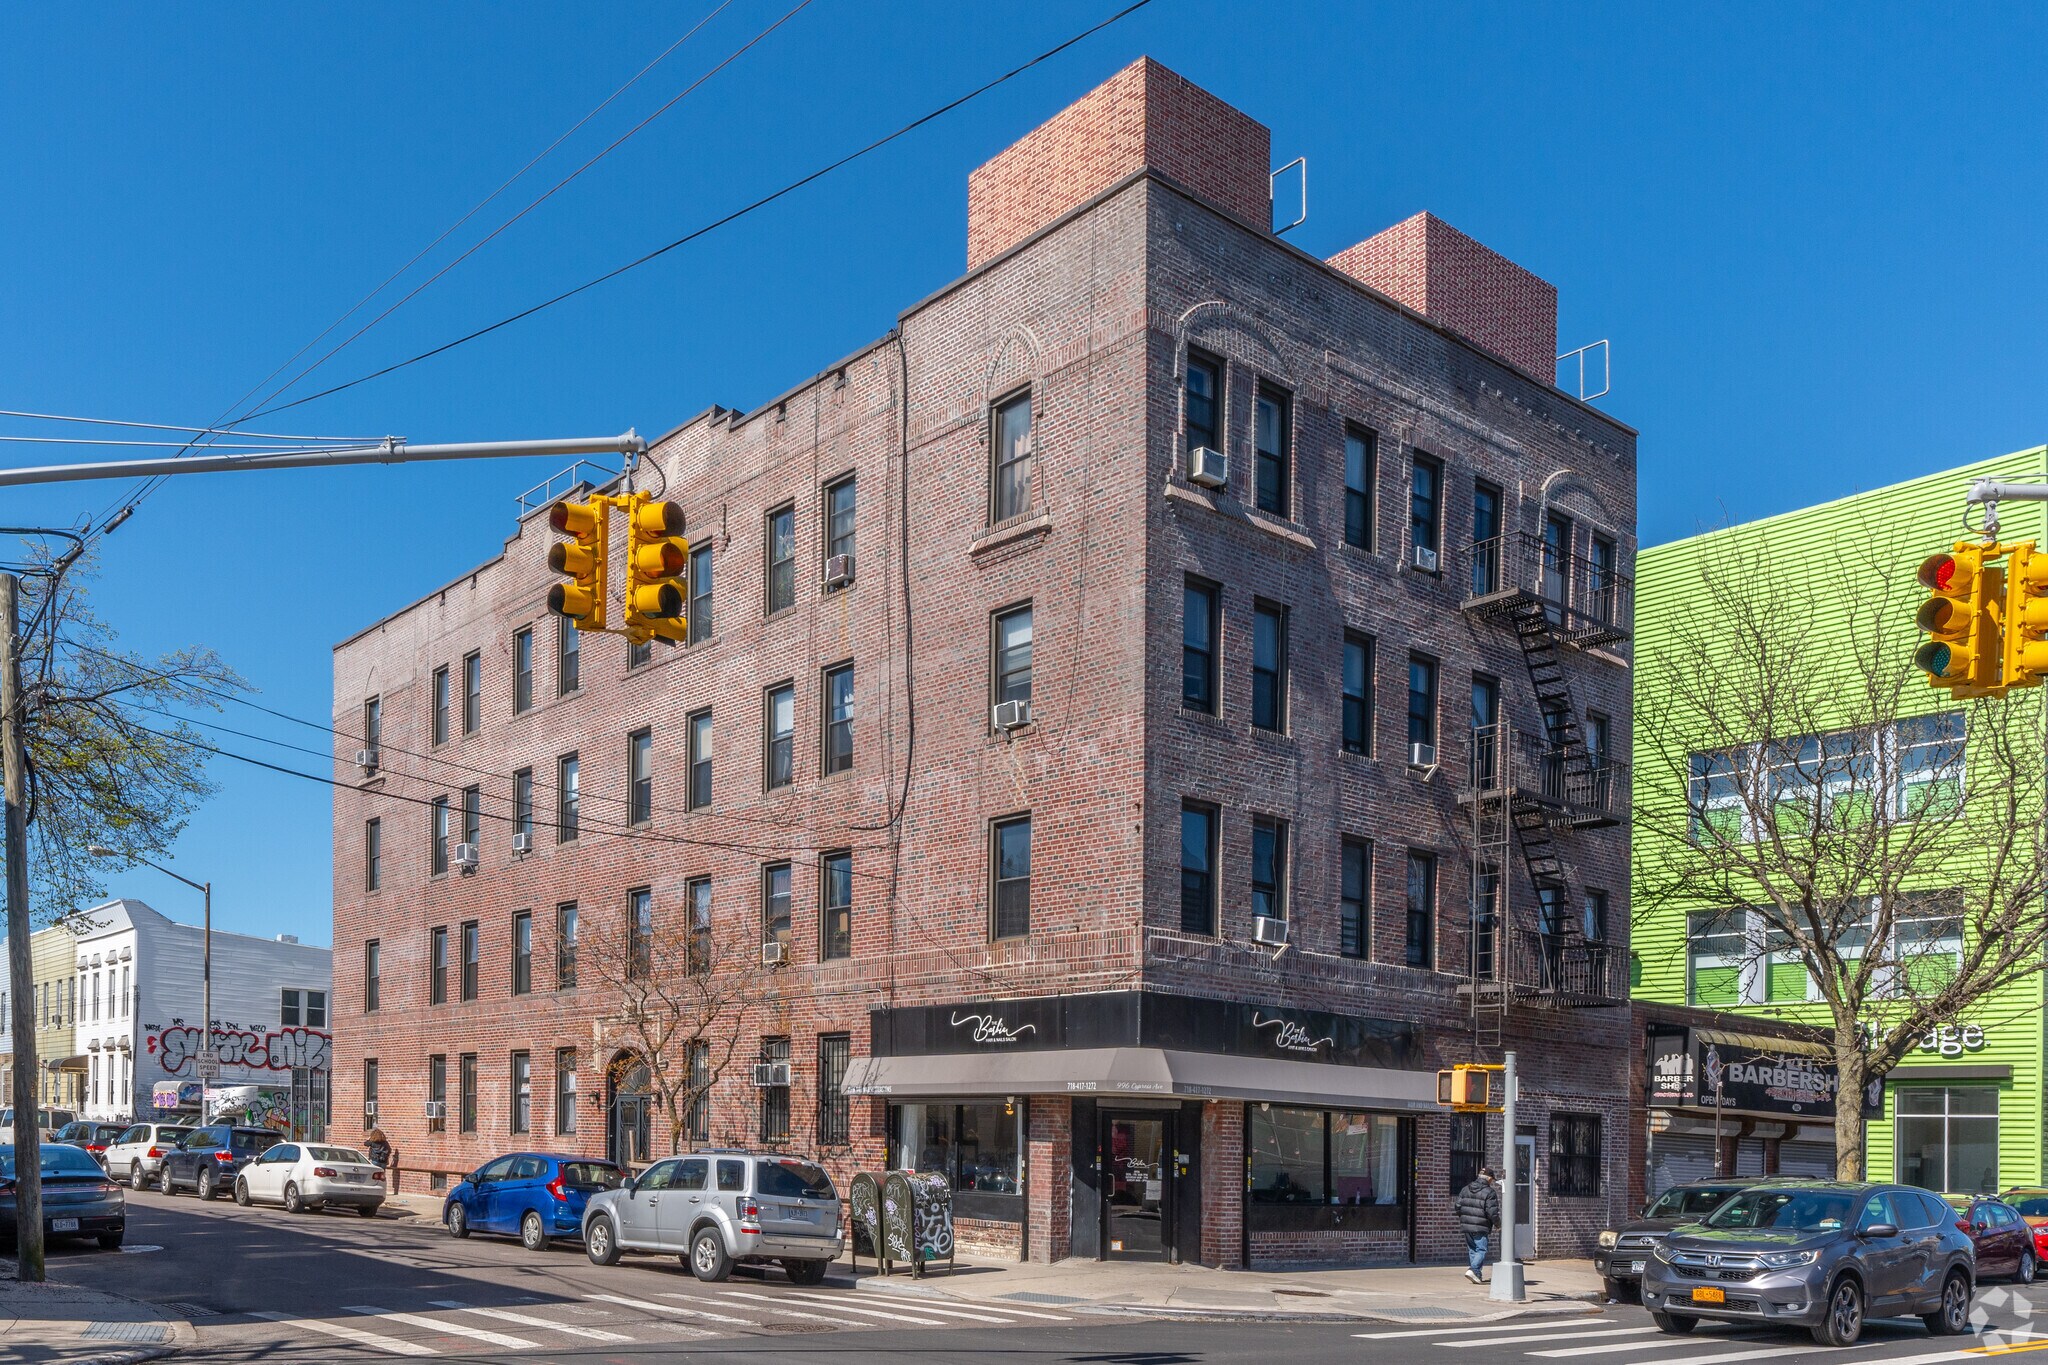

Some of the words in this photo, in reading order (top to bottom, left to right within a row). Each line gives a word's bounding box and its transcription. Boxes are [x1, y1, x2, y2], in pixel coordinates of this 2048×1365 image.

[1729, 1063, 1838, 1092] BARBERSH
[1067, 1082, 1097, 1090] 718-417-1272
[1130, 1082, 1152, 1090] Cypress
[1660, 1082, 1687, 1091] SHOP
[1701, 1095, 1717, 1104] OPEN
[1722, 1098, 1736, 1106] DAYS
